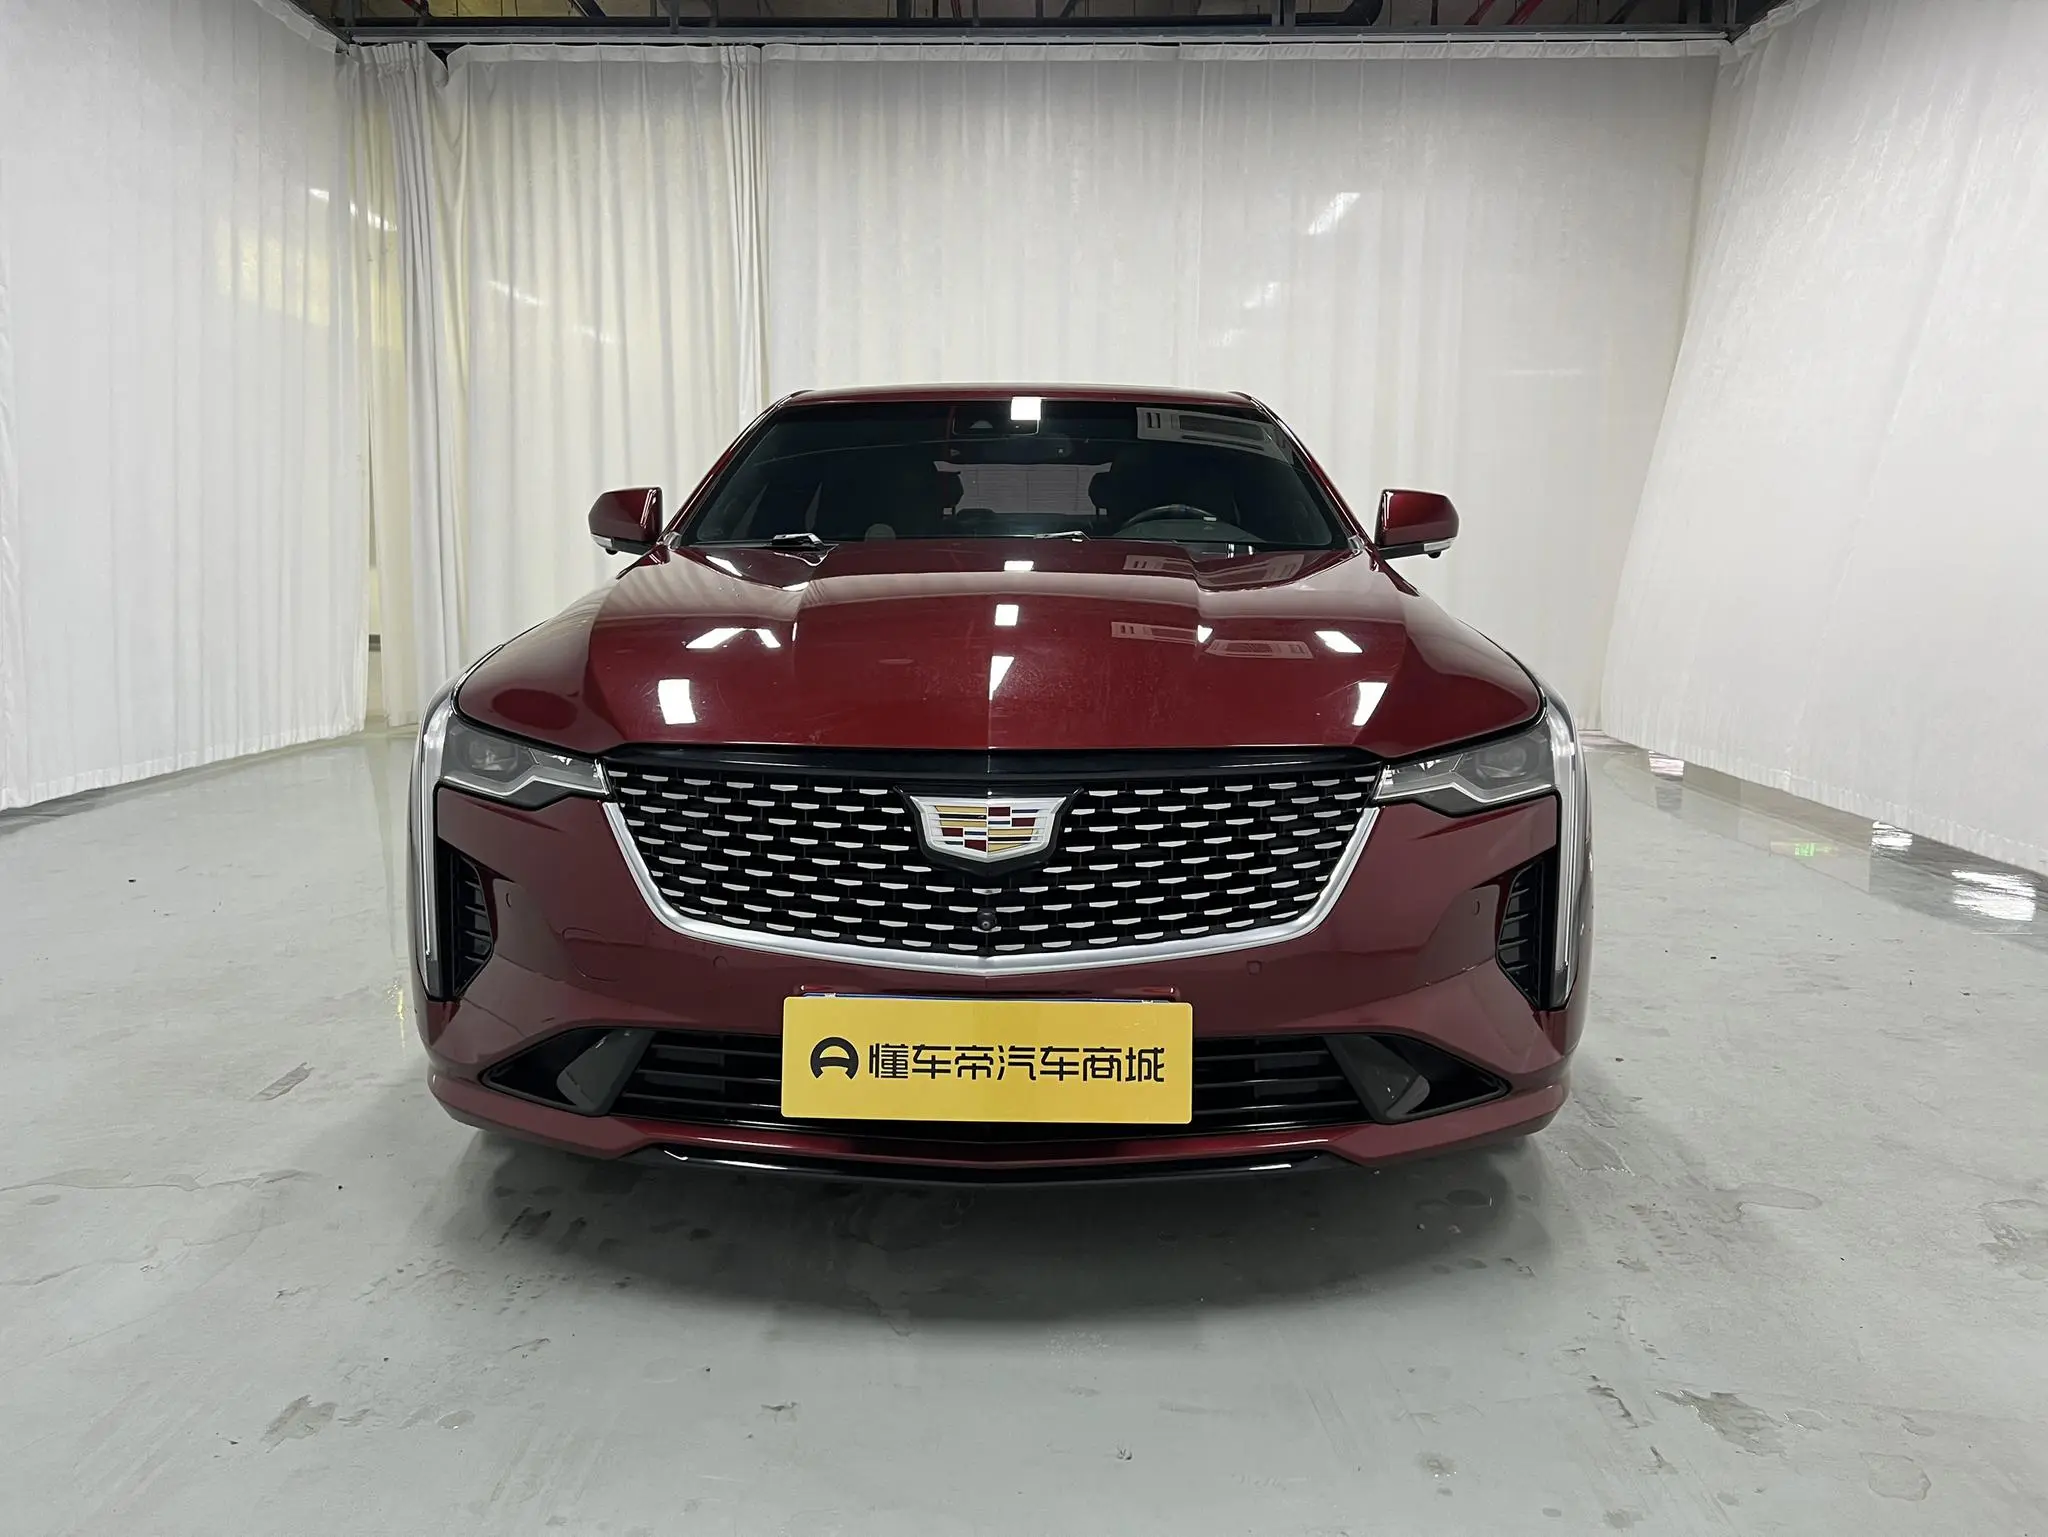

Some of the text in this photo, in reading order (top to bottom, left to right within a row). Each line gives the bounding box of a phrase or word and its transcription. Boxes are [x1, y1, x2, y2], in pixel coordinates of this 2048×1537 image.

[868, 1043, 1165, 1083] 懂车帝汽车商城
